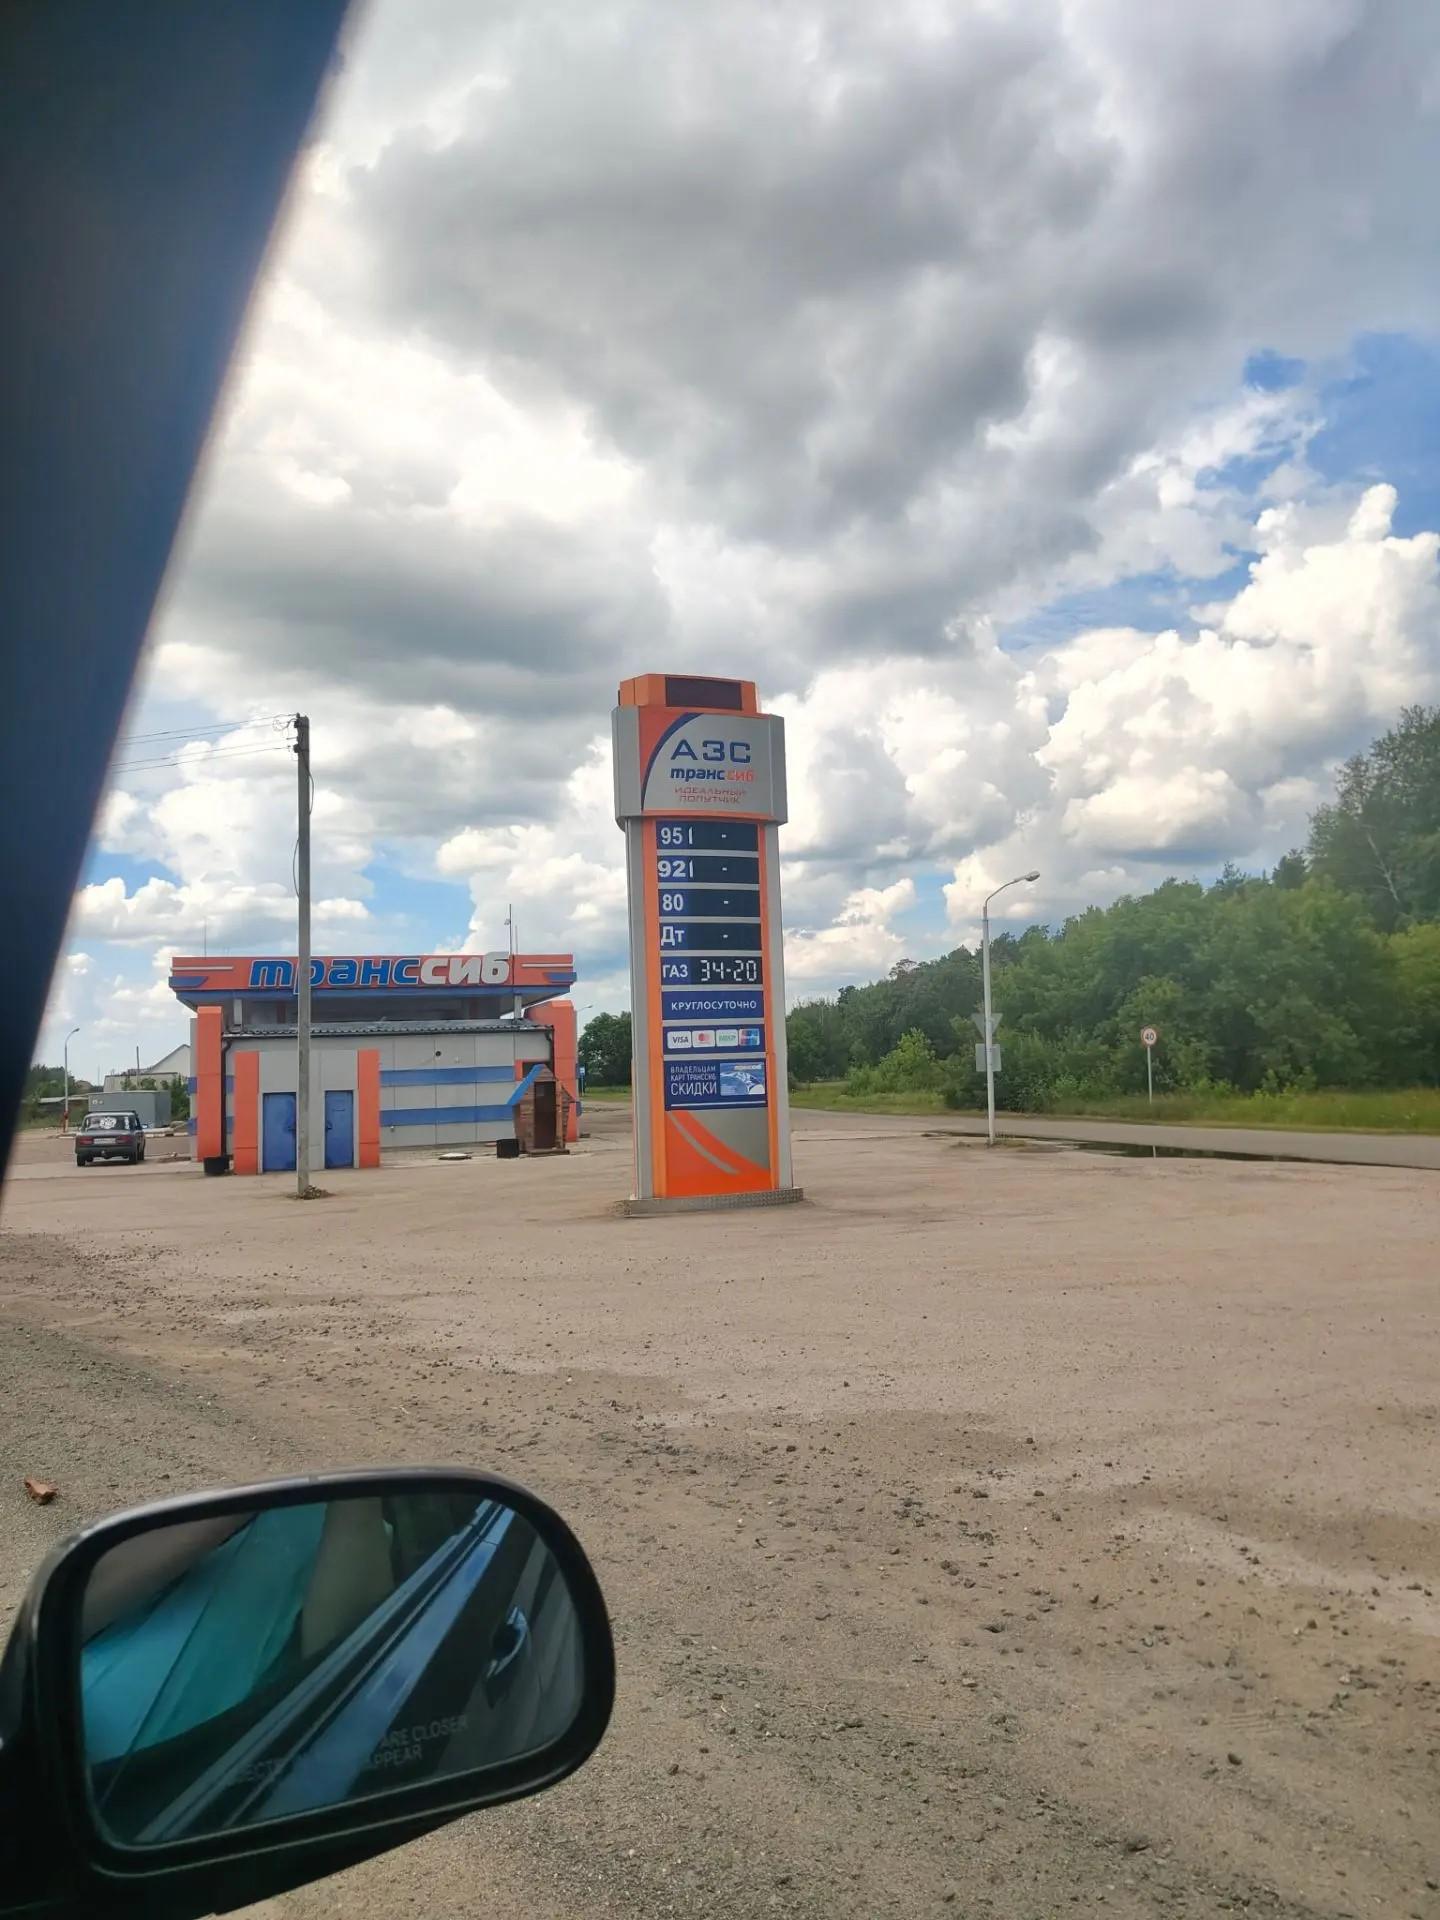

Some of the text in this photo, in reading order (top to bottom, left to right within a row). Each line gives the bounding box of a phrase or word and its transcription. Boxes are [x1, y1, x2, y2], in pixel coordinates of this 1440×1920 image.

[671, 739, 751, 764] АЗС
[662, 893, 684, 911] 80
[662, 959, 757, 982] ГАЗ 34-20
[671, 1000, 757, 1011] КРУГЛОСУТОЧНО
[672, 1036, 689, 1044] VISA
[670, 1065, 716, 1074] ВЛАДЕЛЬЦАМ
[671, 1081, 717, 1097] СКИДКИ
[366, 1744, 422, 1769] PPEAR
